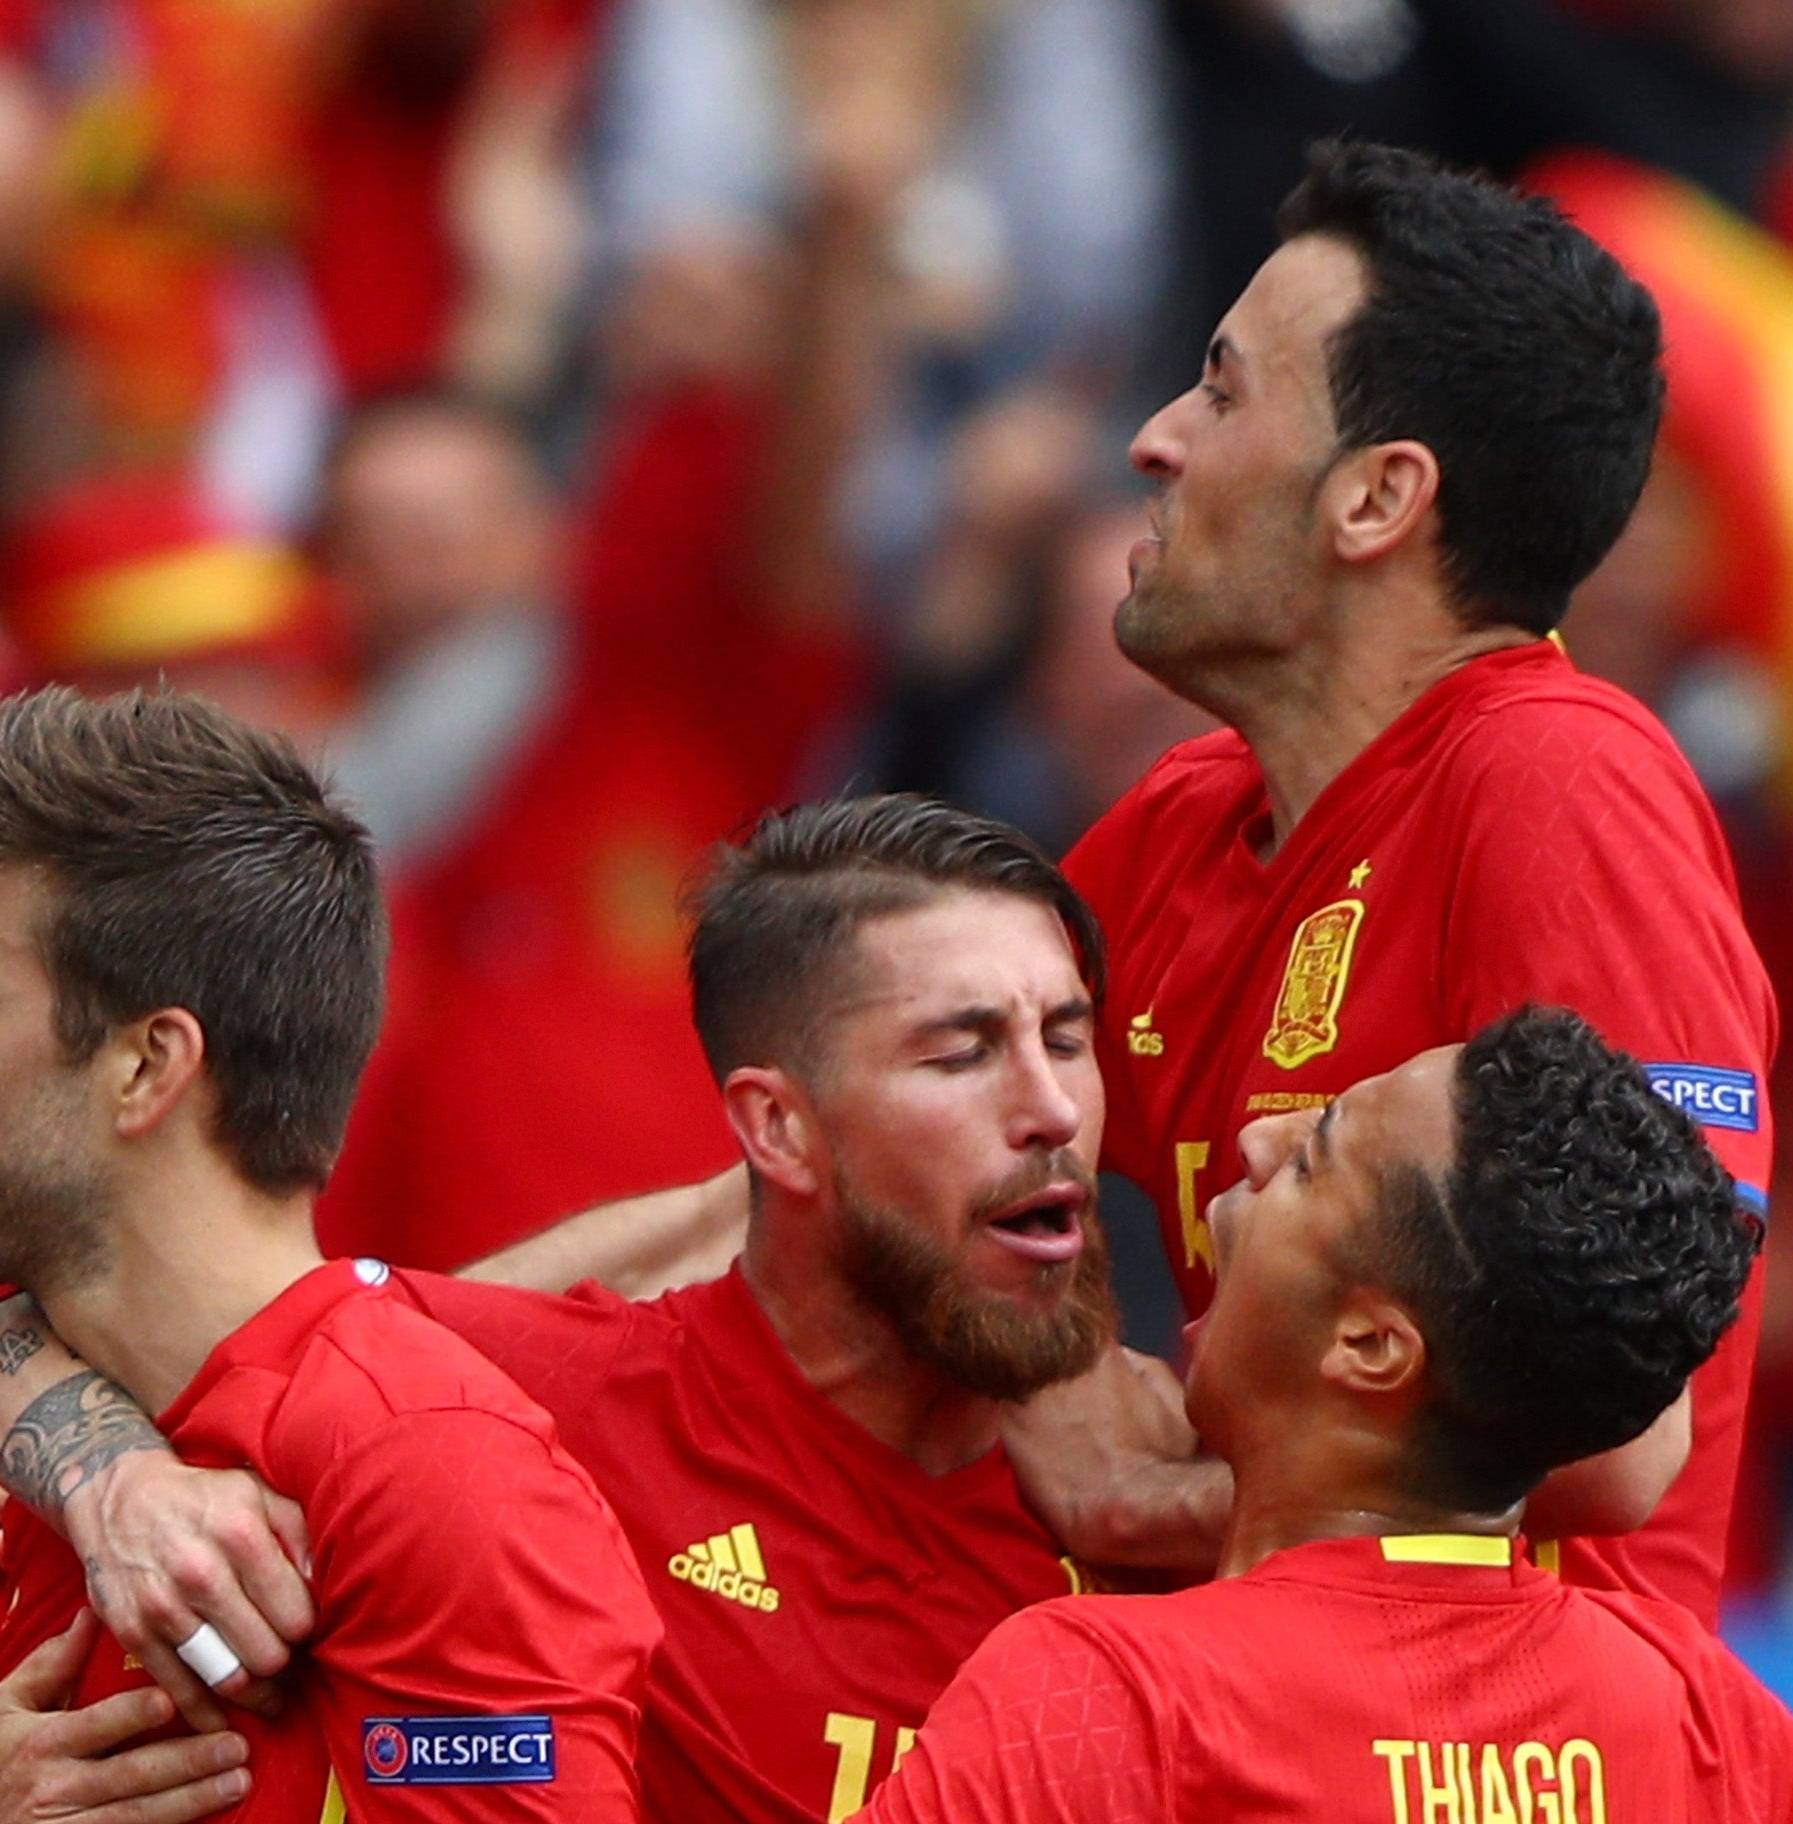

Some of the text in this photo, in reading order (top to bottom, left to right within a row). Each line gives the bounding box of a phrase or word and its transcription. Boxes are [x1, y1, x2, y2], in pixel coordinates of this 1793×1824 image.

[1650, 1079, 1756, 1115] SPECT
[667, 1553, 780, 1613] adidas
[411, 1733, 553, 1766] RESPECT
